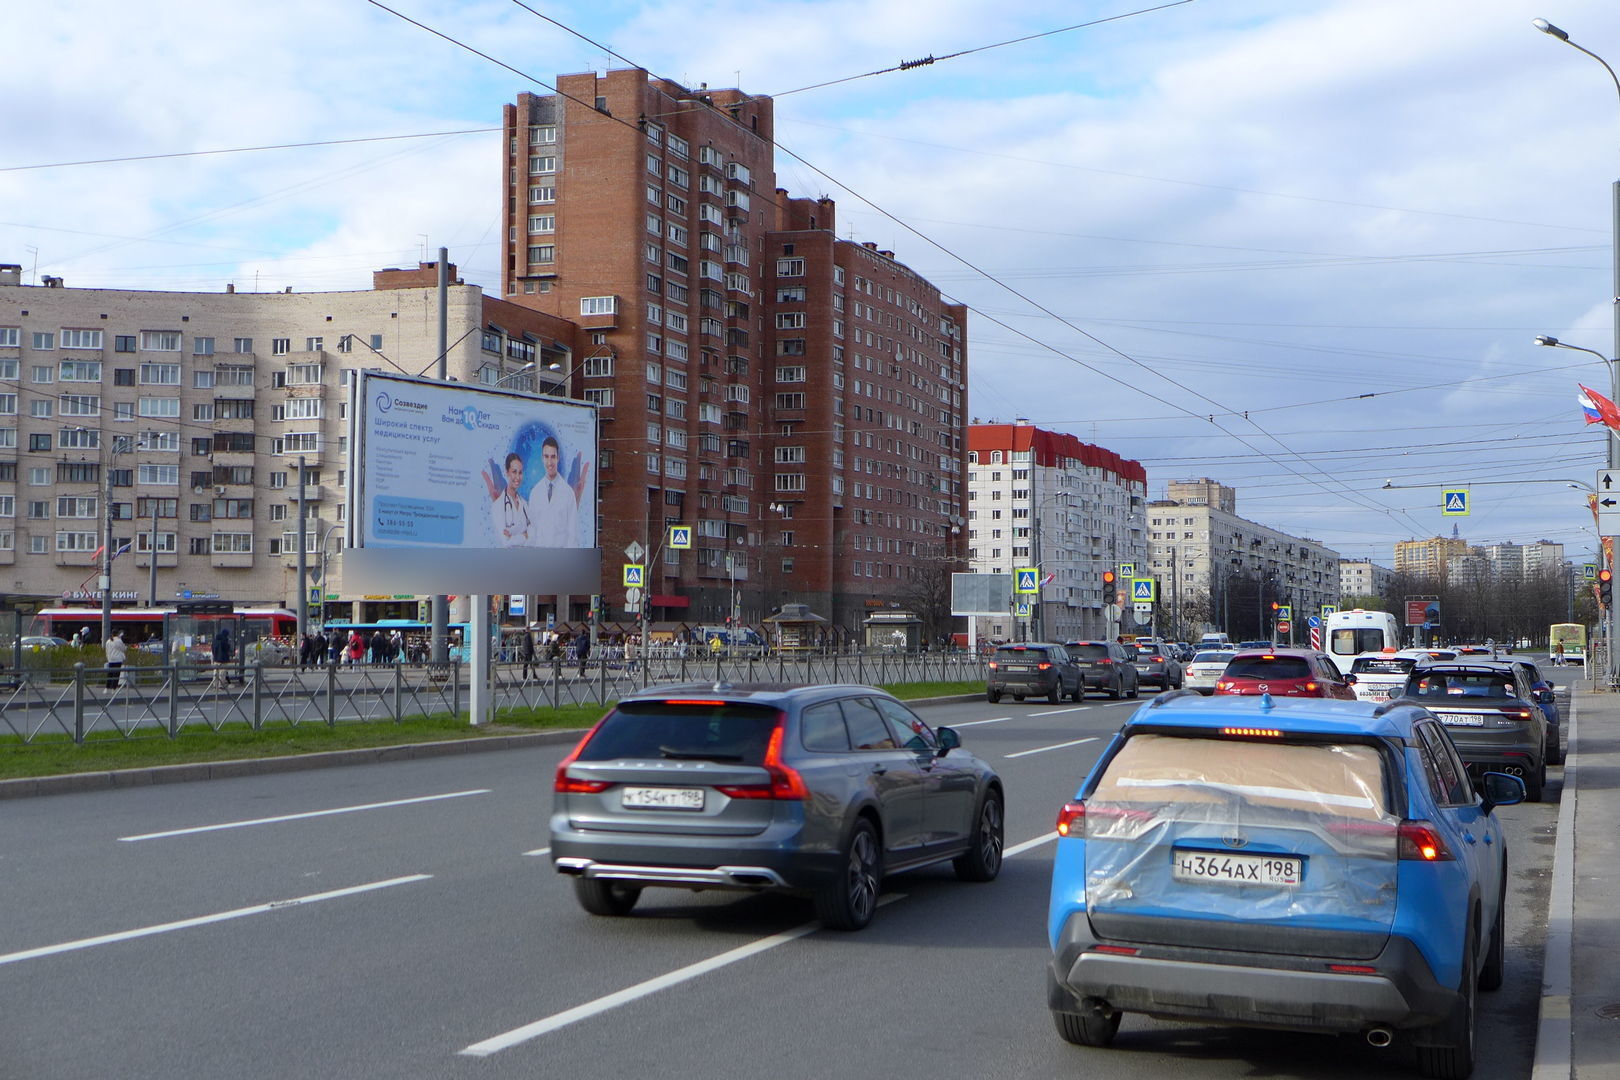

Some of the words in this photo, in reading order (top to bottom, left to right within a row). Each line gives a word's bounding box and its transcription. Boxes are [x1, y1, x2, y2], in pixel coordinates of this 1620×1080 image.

[394, 398, 428, 411] Созвездие
[448, 405, 464, 416] Нам
[477, 409, 491, 420] Лет
[374, 417, 408, 428] Широкий
[409, 423, 433, 433] спектр
[441, 414, 455, 423] Вам
[455, 417, 464, 425] до
[477, 420, 500, 431] Скидка
[374, 429, 421, 441] медицинских
[422, 435, 441, 444] услуг
[73, 591, 104, 599] БУРГЕ
[112, 591, 138, 599] КИНГ
[1181, 856, 1259, 880] Н364АХ
[1264, 860, 1294, 877] 198
